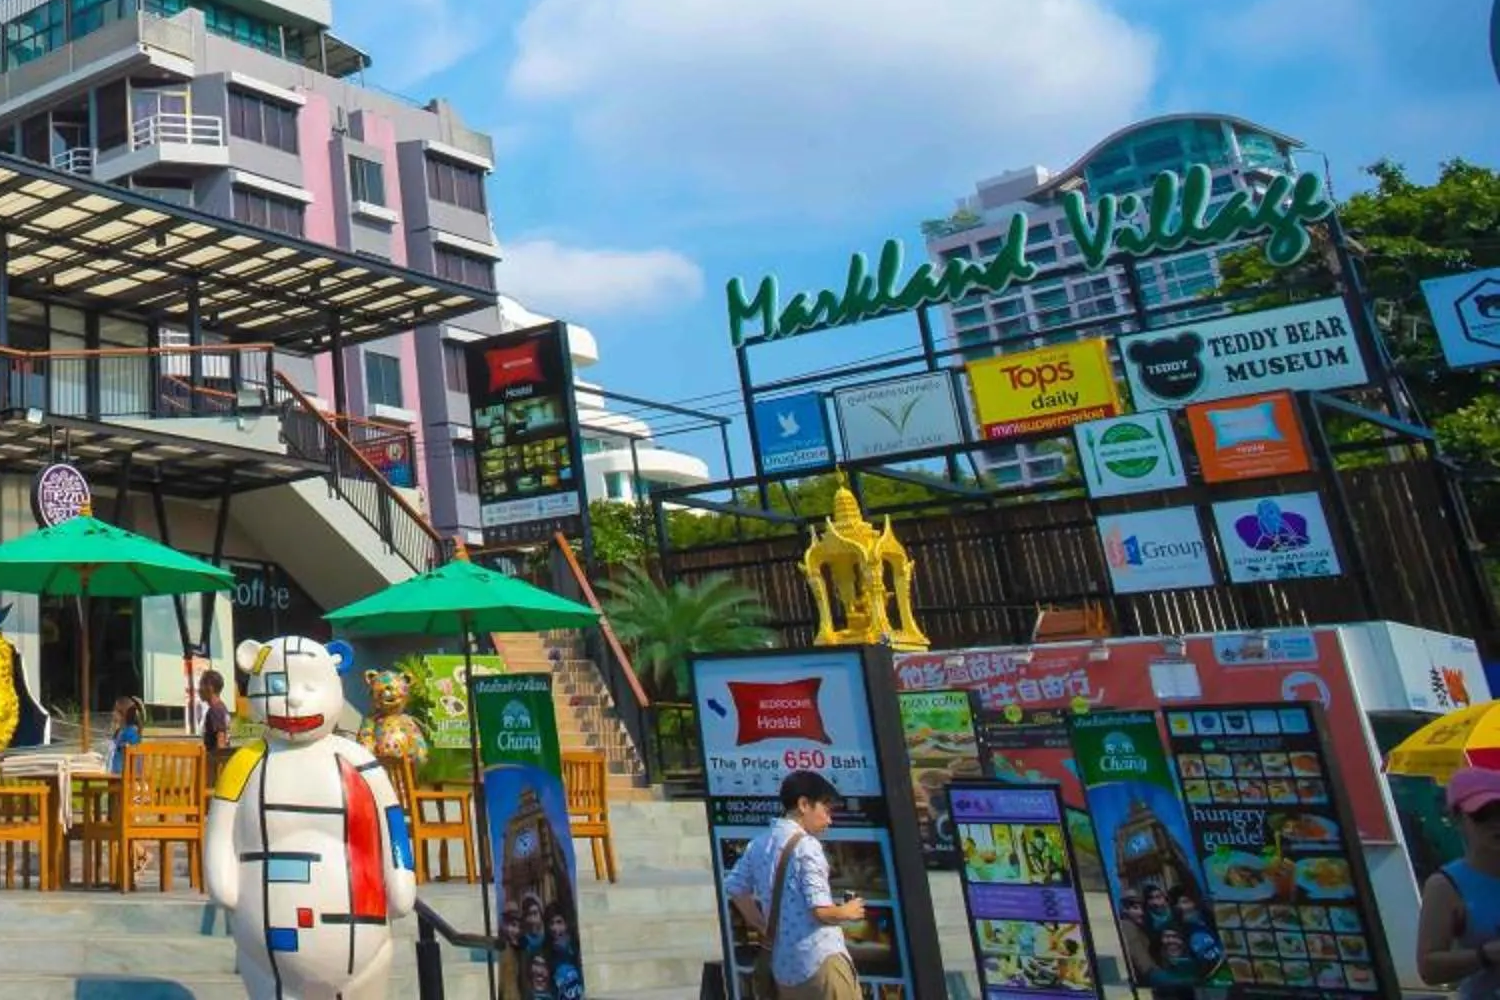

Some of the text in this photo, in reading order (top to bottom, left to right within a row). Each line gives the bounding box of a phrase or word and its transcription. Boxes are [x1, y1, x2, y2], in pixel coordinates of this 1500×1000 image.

[725, 163, 1334, 349] Markland Village
[1207, 315, 1347, 358] TEDDY BEAR
[1147, 359, 1189, 376] TEDDY
[1224, 346, 1349, 383] MUSEUM
[1000, 360, 1075, 392] Tops
[1031, 389, 1079, 410] daily
[1142, 540, 1204, 559] Group
[756, 714, 803, 729] Hostel
[497, 730, 542, 755] Chang
[710, 757, 737, 770] The
[741, 756, 780, 770] Price
[784, 750, 826, 769] 650
[1100, 755, 1148, 775] Chang
[1193, 805, 1266, 827] hungry
[1203, 827, 1265, 851] guide!
